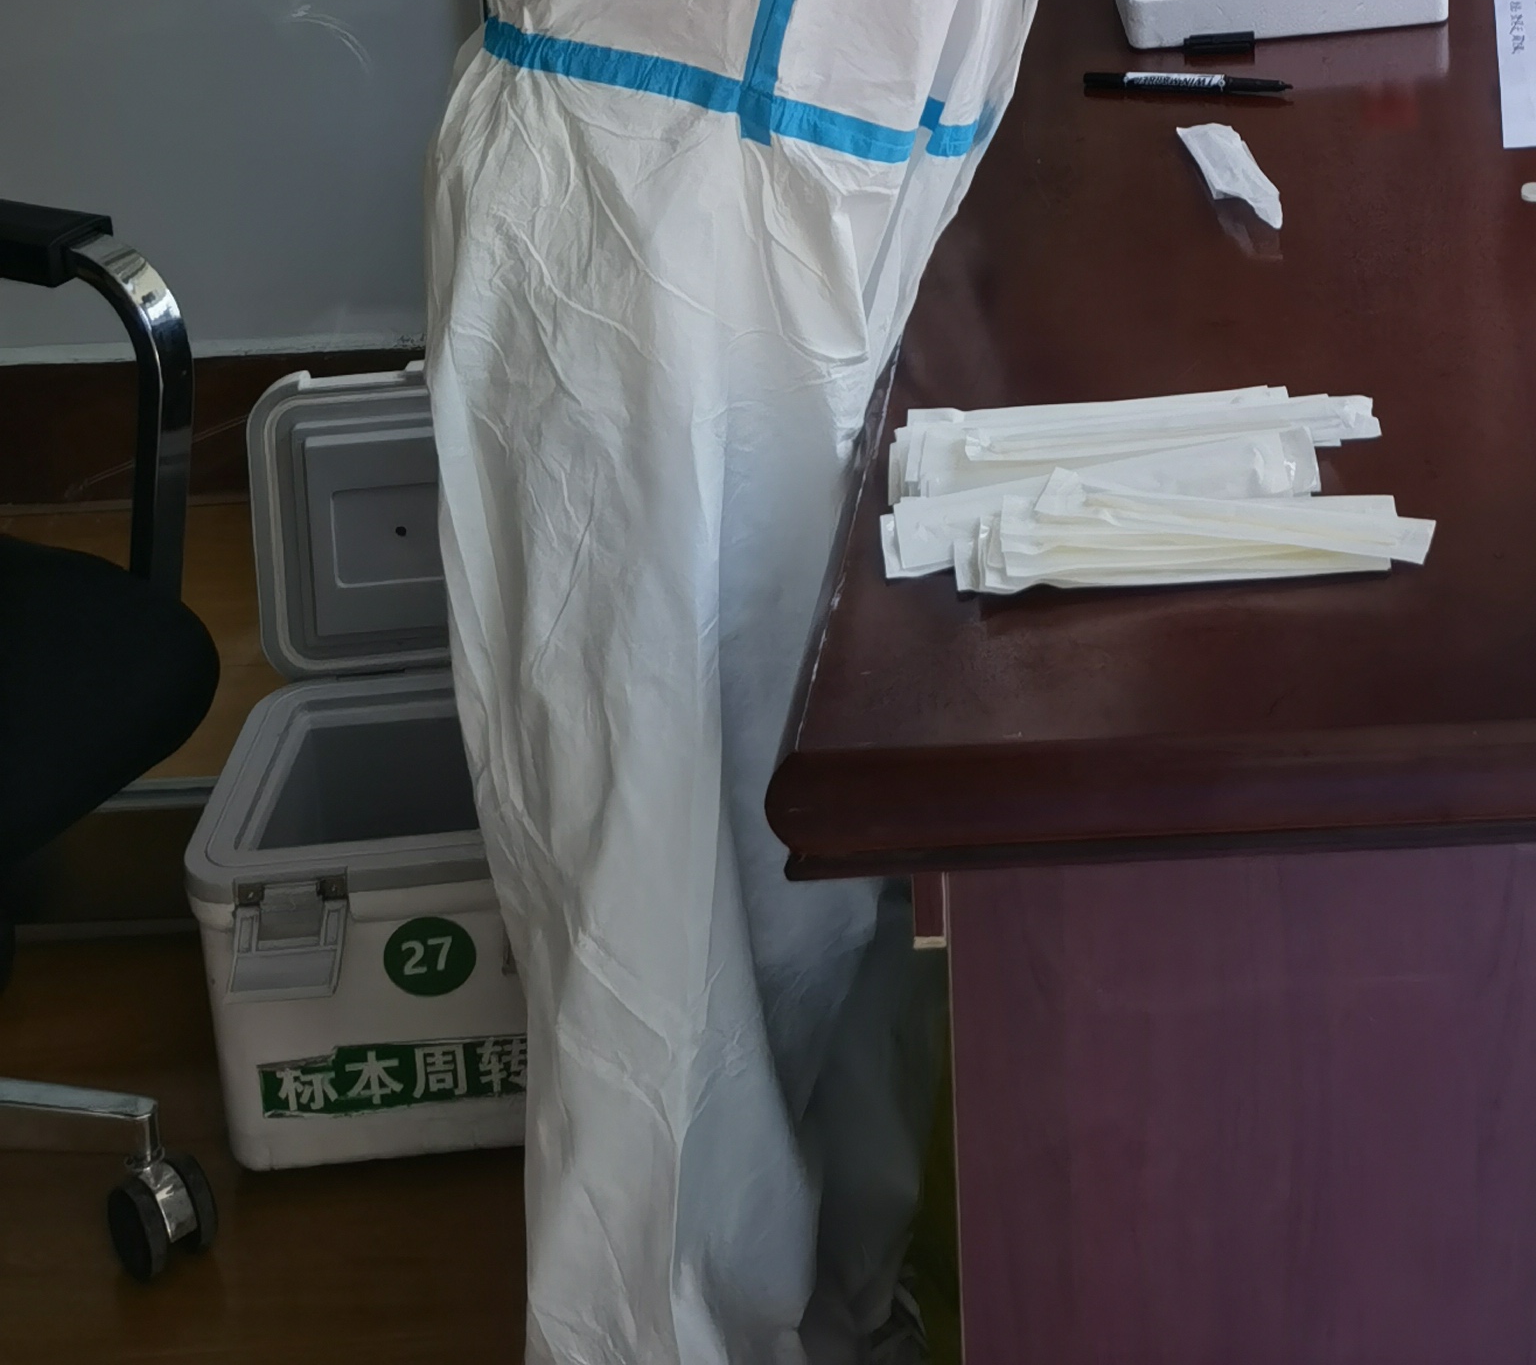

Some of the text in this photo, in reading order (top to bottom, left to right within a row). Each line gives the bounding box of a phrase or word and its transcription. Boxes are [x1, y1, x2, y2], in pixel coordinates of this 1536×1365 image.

[400, 935, 453, 976] 27
[276, 1037, 528, 1111] 标本周转
